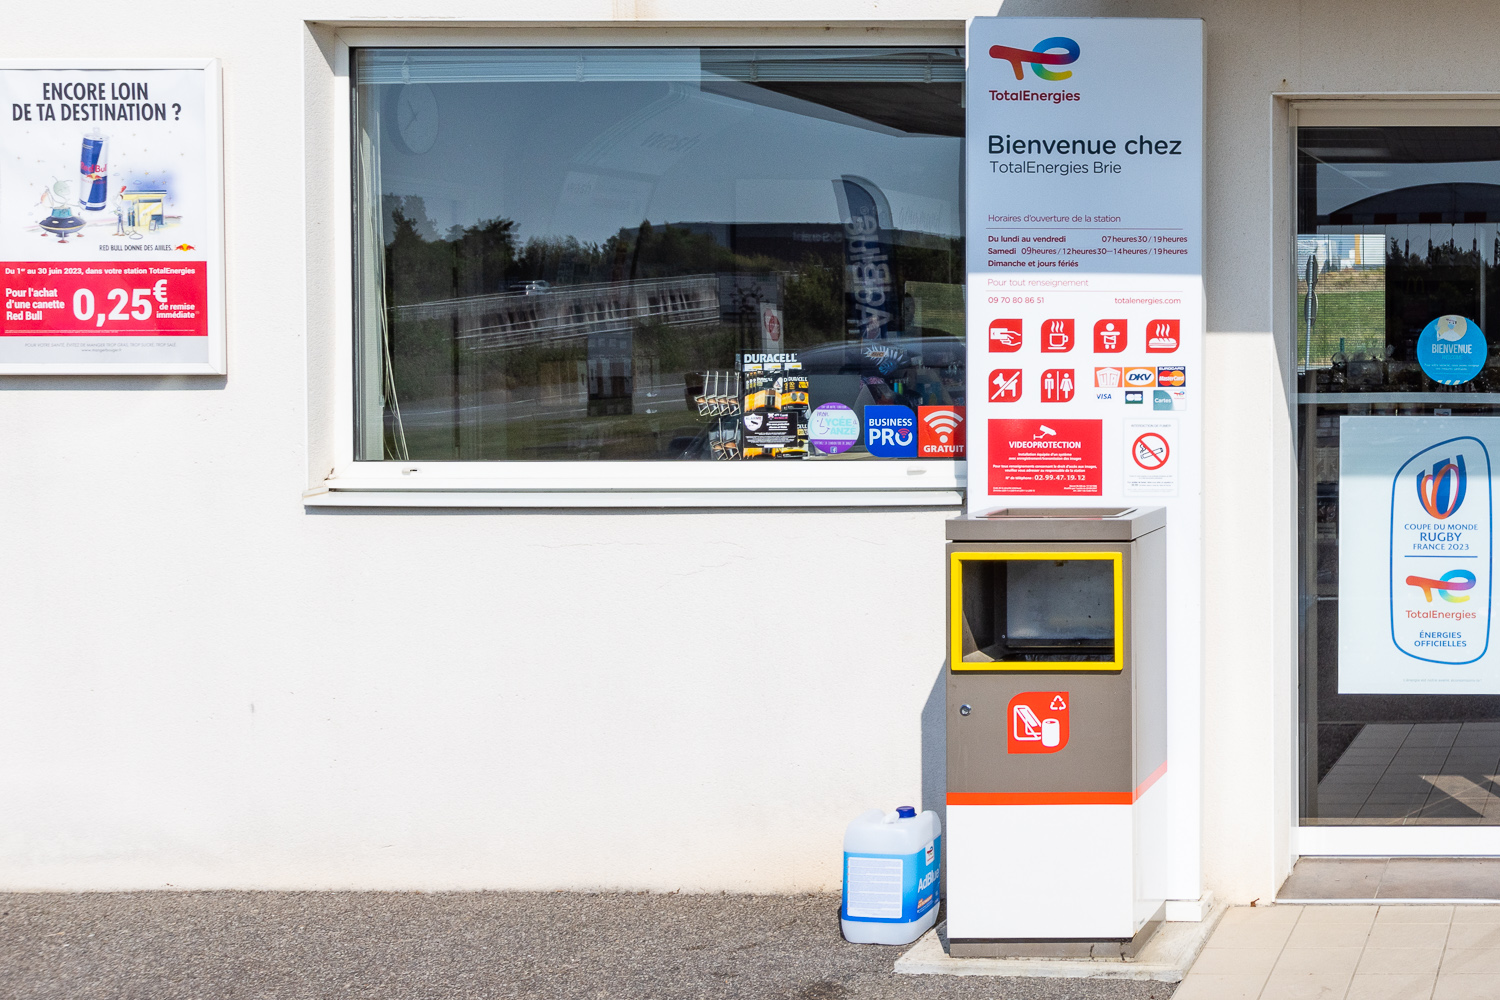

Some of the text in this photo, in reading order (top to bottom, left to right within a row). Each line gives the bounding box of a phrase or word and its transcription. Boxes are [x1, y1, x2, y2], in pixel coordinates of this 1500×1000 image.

[43, 82, 148, 101] ENCORE LOIN
[989, 90, 1081, 104] TotalEnergies
[12, 103, 182, 122] DE TA DESTINATION ?
[988, 135, 1182, 155] Bienvenue chez
[990, 161, 1122, 176] TotalEnergies Brie
[988, 214, 1121, 223] Horaires d'ouverture de la station
[988, 235, 999, 243] Du
[1000, 235, 1020, 243] lundi
[1032, 235, 1067, 243] vendredi
[987, 247, 1017, 255] Samedi
[1036, 260, 1056, 268] jours
[49, 268, 63, 276] juin
[64, 268, 84, 276] 2023,
[149, 268, 195, 276] TotalEnergies
[987, 278, 1089, 288] Pour tout renseignement
[5, 288, 58, 298] Pour l'achat
[6, 300, 65, 309] d'une canette
[988, 296, 1045, 304] 09 70 80 86 51
[1114, 297, 1181, 305] totalenergies.com
[159, 303, 195, 311] de remise
[6, 311, 43, 321] Red Bull
[156, 311, 195, 319] immédiate
[1432, 344, 1472, 354] BIENVENUE
[744, 353, 797, 363] DURACELL
[1128, 373, 1152, 381] DKV
[869, 418, 912, 427] BUSINESS
[869, 427, 913, 446] PRO
[924, 445, 964, 453] GRATUIT
[1009, 441, 1081, 449] VIDEOPROTECTION
[1404, 523, 1478, 531] COUPE DU MONDE
[1420, 532, 1462, 542] RUGBY
[1413, 543, 1470, 551] FRANCE 2023
[1405, 610, 1477, 621] TotalEnergies
[1419, 630, 1462, 639] ÉNERGIES
[917, 868, 940, 893] AdBlue
